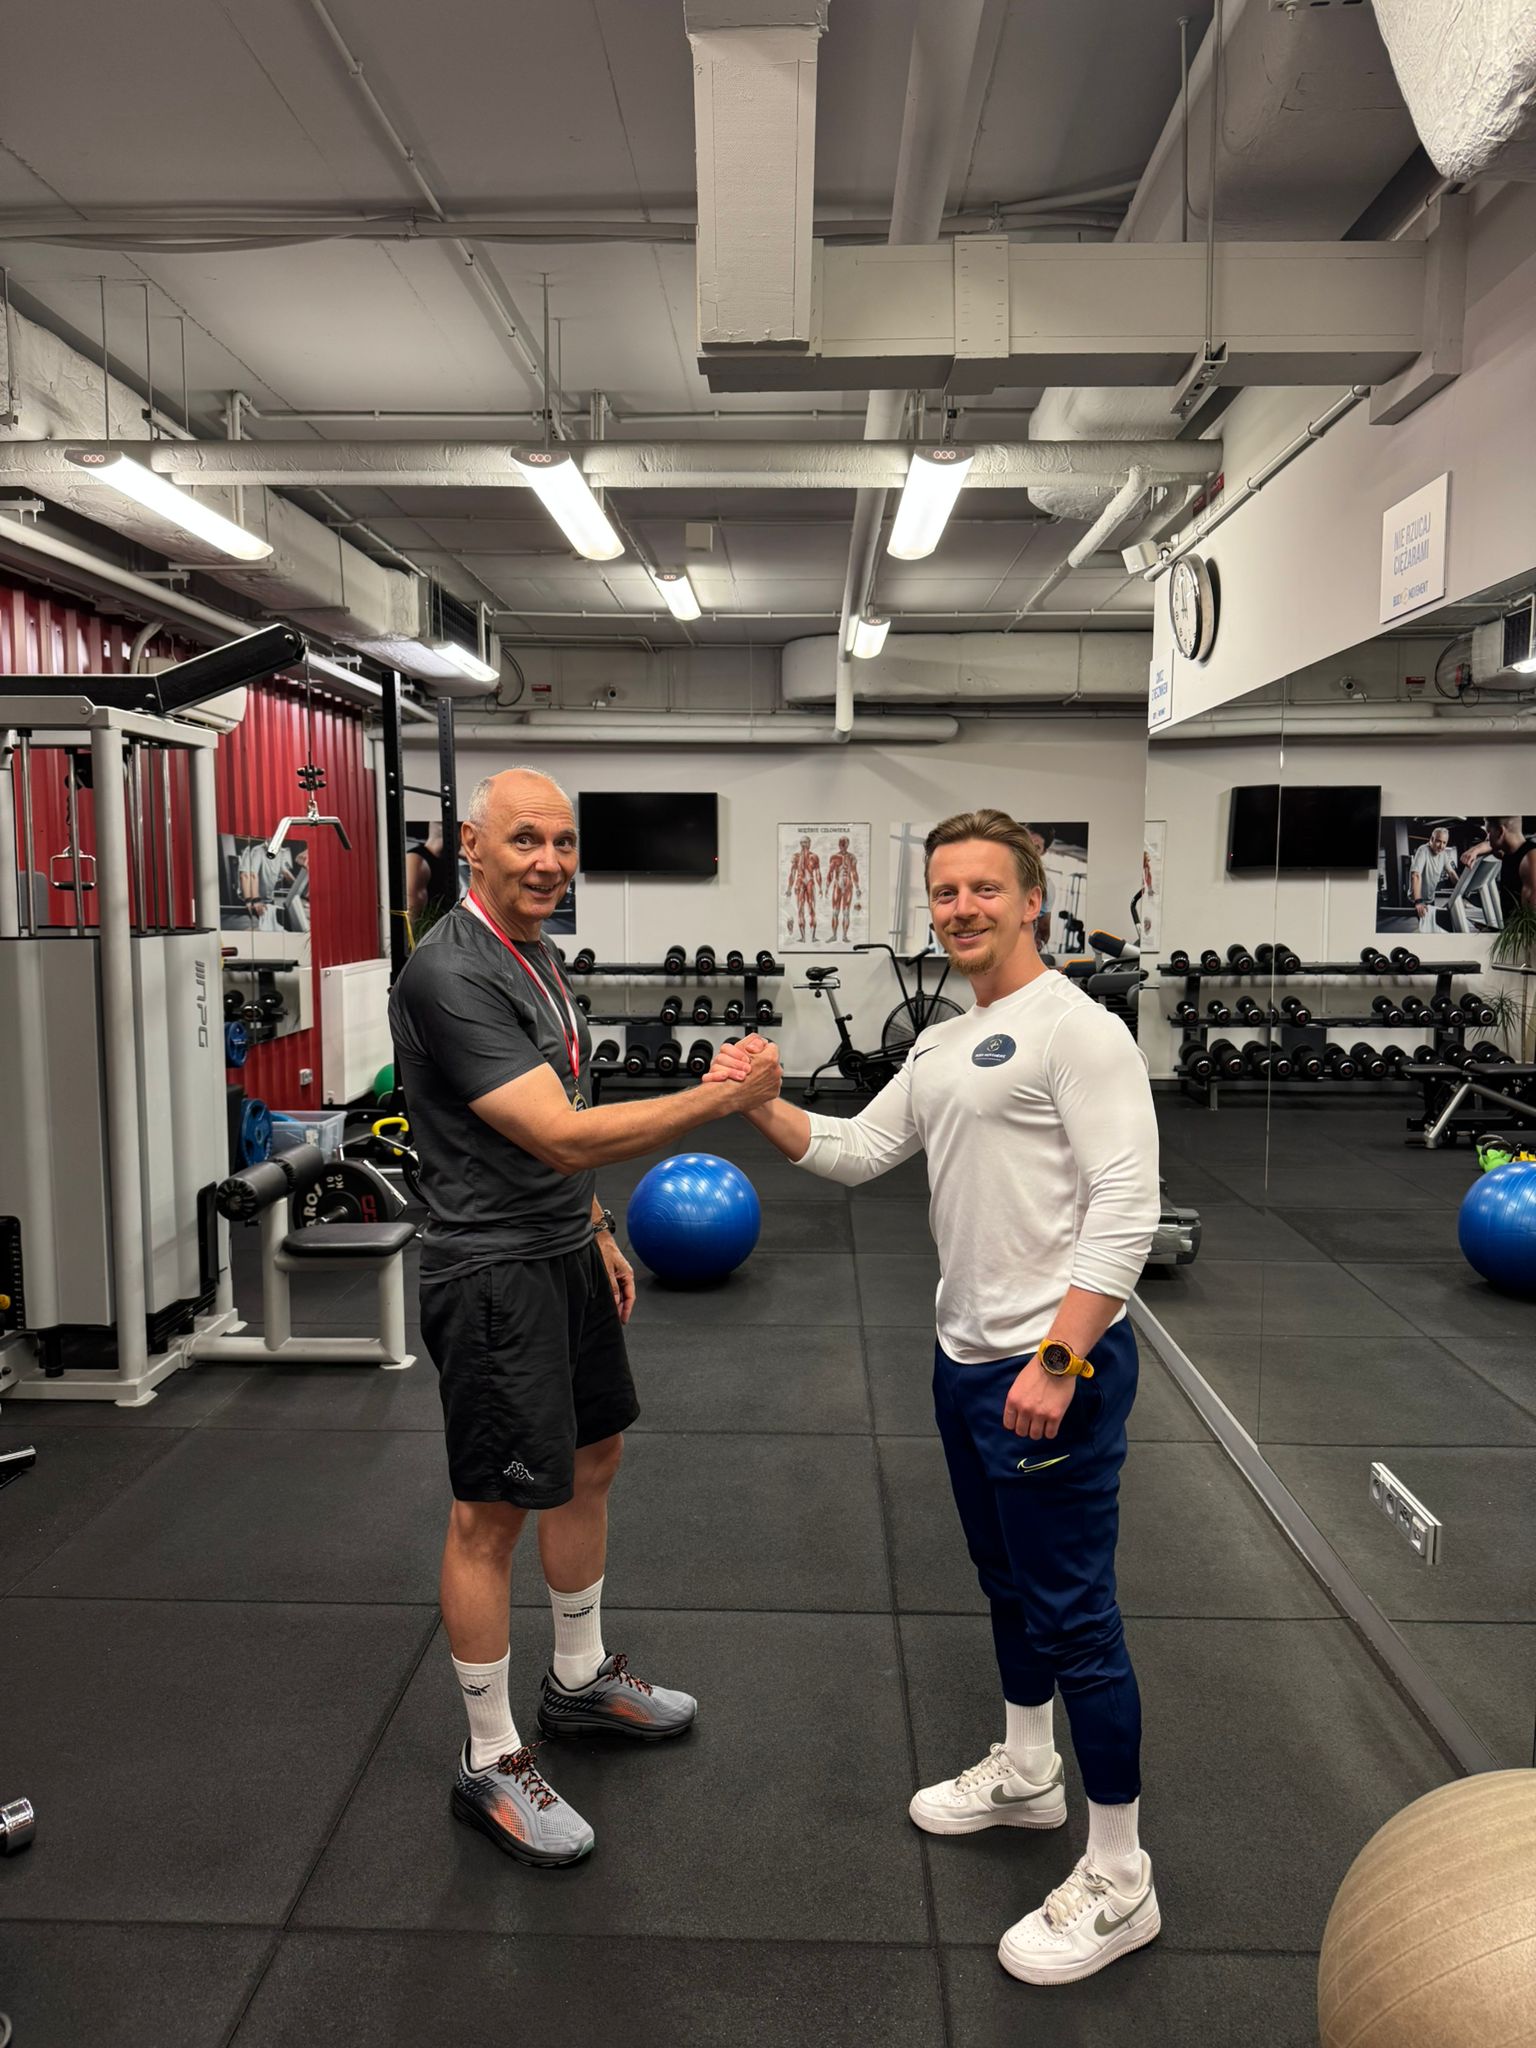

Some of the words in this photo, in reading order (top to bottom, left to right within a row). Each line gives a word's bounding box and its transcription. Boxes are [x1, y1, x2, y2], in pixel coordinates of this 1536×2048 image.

[1393, 528, 1405, 551] NIE
[1405, 512, 1431, 542] RZUCAJ
[1393, 539, 1429, 576] CIĘŻARAMI
[335, 1174, 344, 1189] KG
